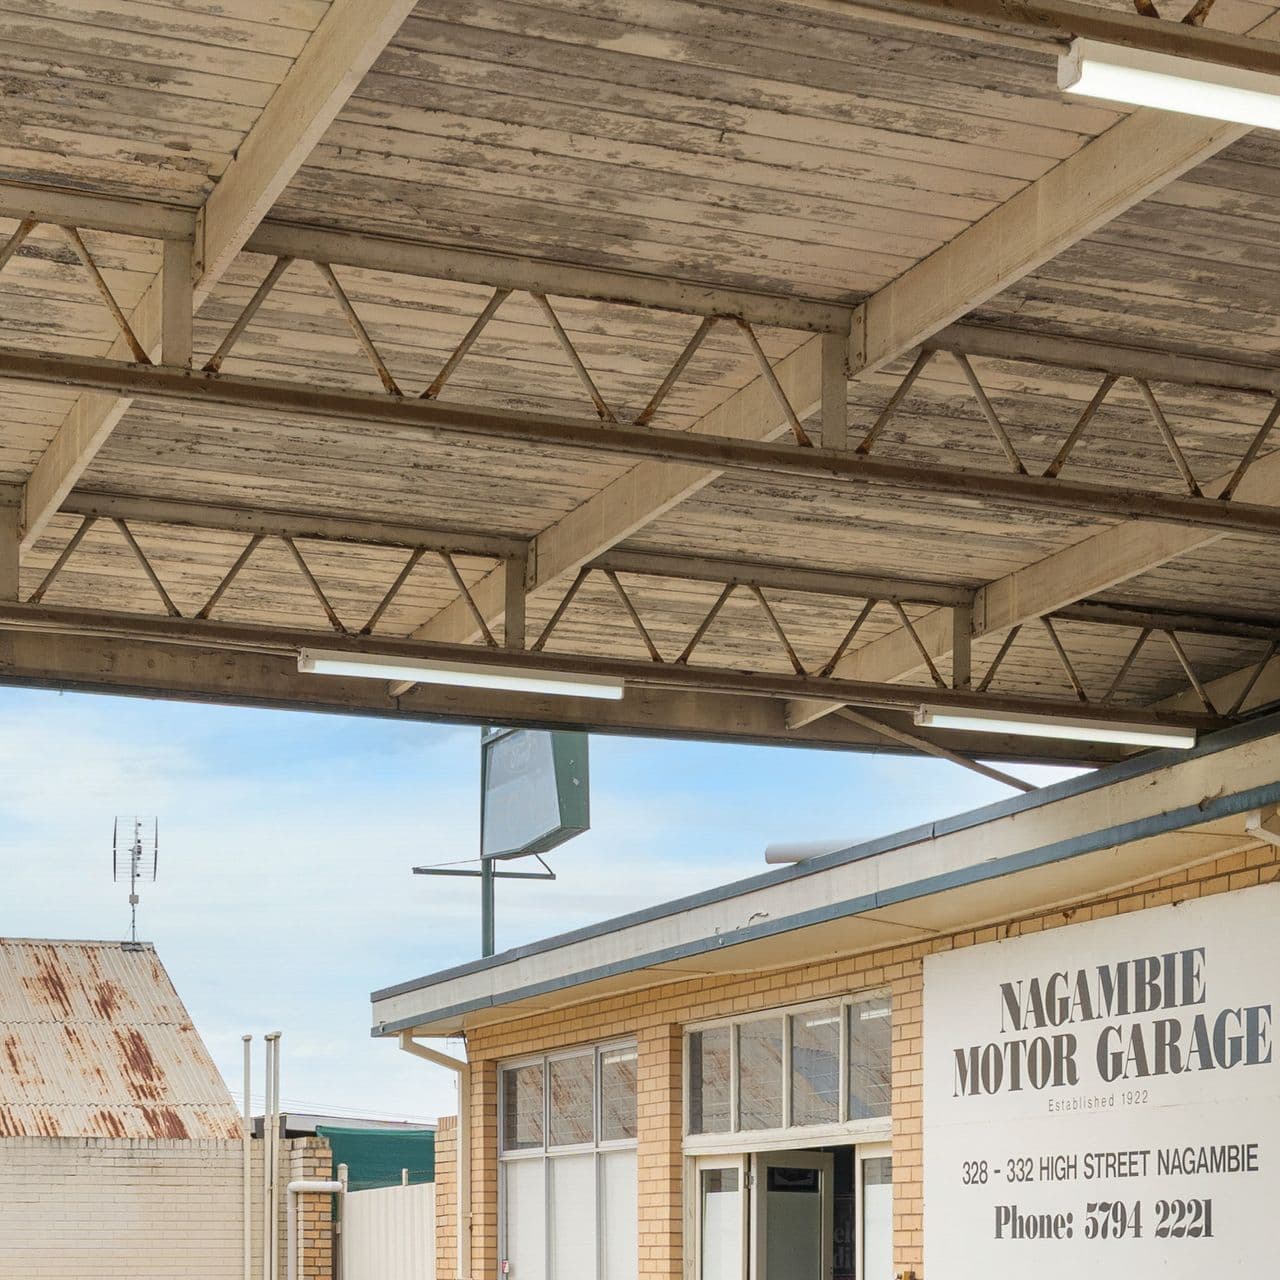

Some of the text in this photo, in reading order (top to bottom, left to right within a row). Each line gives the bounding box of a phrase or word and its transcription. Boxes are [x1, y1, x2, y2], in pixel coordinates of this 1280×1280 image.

[999, 947, 1206, 1033] NAGAMBIE
[953, 1004, 1272, 1098] MOTOR GARAGE
[1048, 1090, 1149, 1112] Established 1922
[962, 1159, 988, 1185] 328
[1006, 1158, 1034, 1183] 332
[1039, 1154, 1077, 1181] HIGH
[1083, 1150, 1151, 1180] STREET
[1157, 1143, 1259, 1176] NAGAMBIE
[994, 1198, 1215, 1240] Phone: 5794 2221
